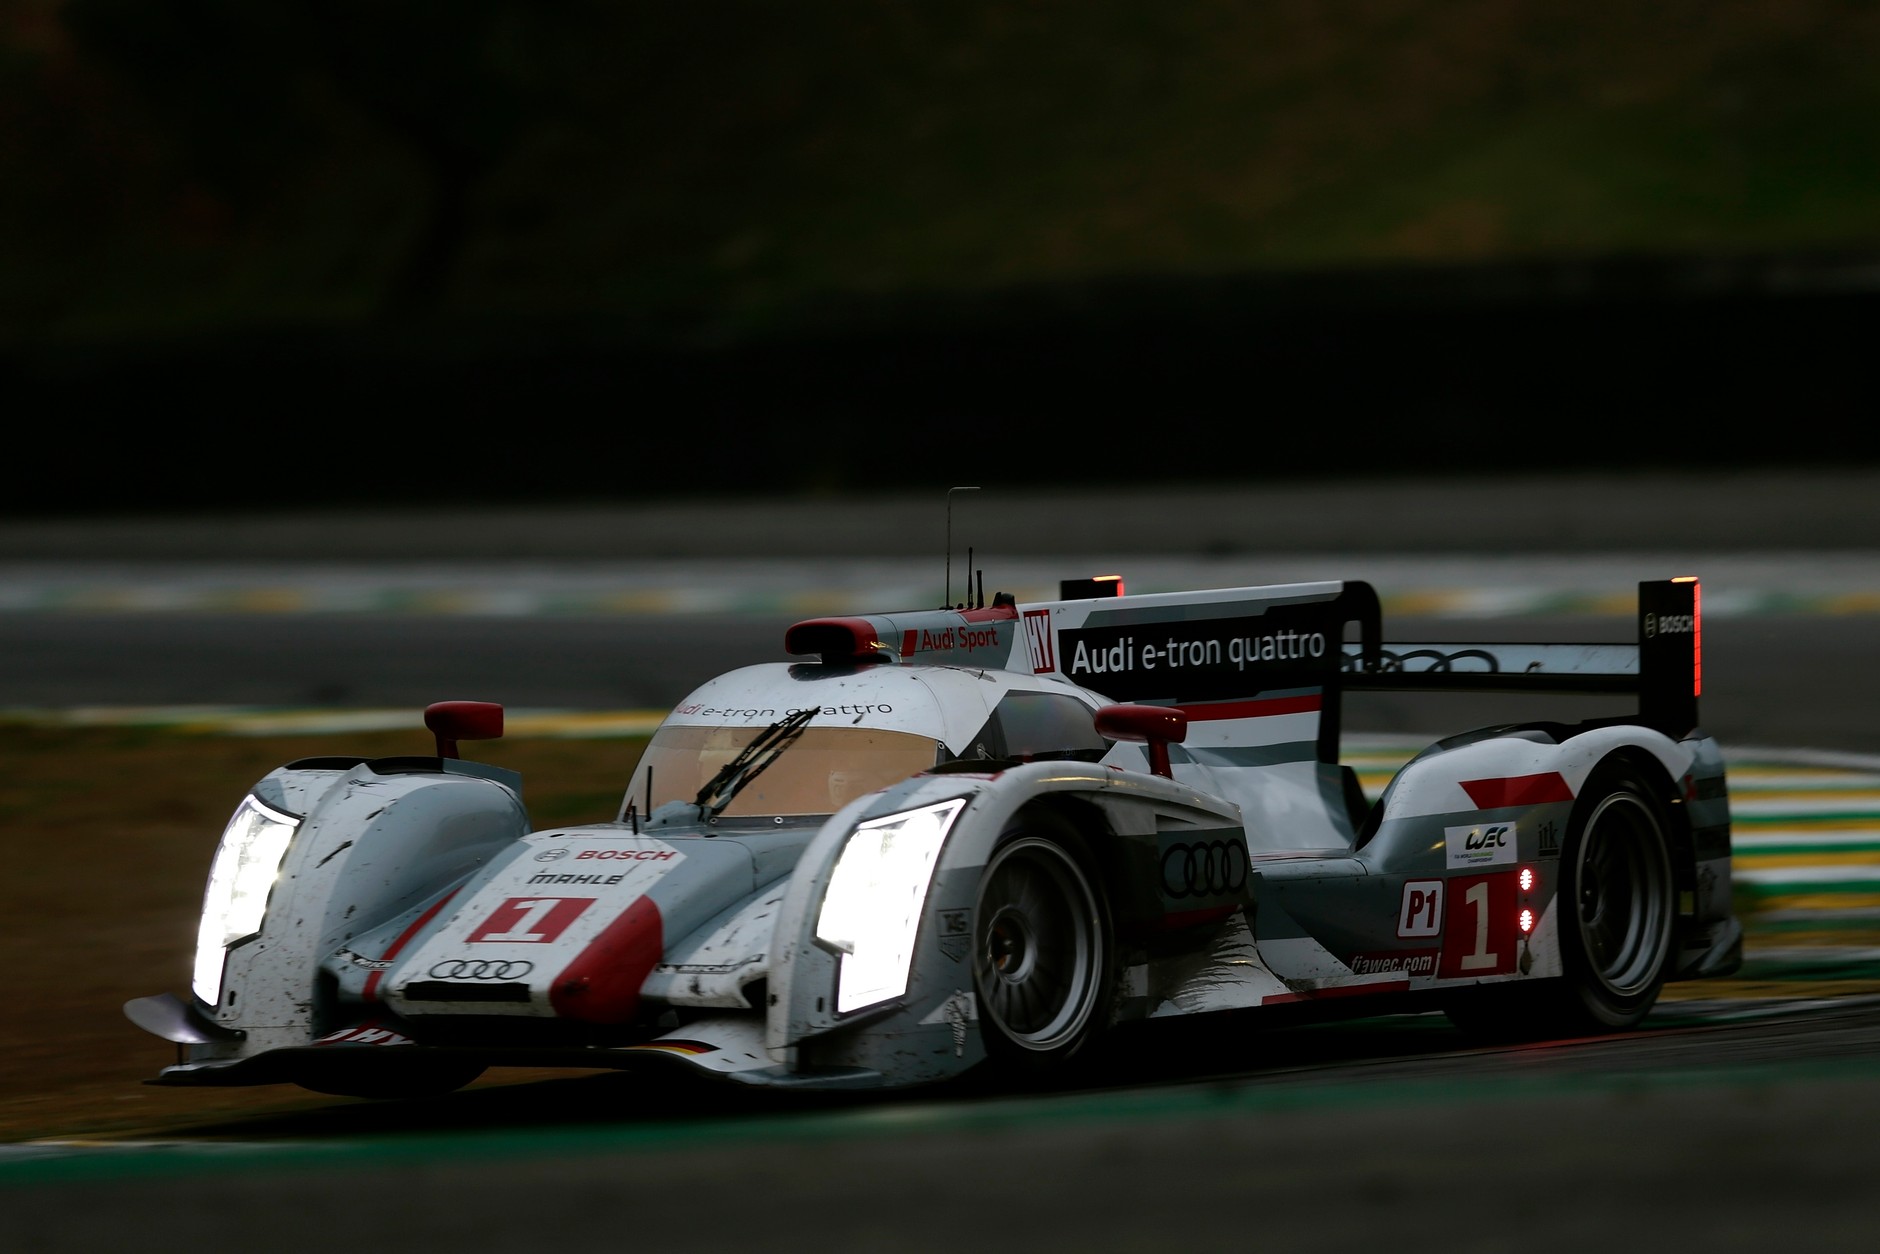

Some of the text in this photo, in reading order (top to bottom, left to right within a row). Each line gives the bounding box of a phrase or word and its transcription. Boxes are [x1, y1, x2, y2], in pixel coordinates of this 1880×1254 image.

[1659, 615, 1694, 634] BOSCH
[922, 626, 998, 652] Audi Sport
[1025, 614, 1051, 669] HY
[1071, 629, 1326, 675] Audi e-tron quattro
[702, 707, 775, 718] e-tron
[785, 703, 893, 720] qattro
[1466, 827, 1508, 850] WEC
[575, 850, 677, 861] BOSCH
[527, 874, 624, 885] MAHLE
[480, 898, 563, 942] 1
[1406, 890, 1437, 929] P1
[1460, 881, 1498, 971] 1
[1351, 954, 1433, 974] fiawec.com
